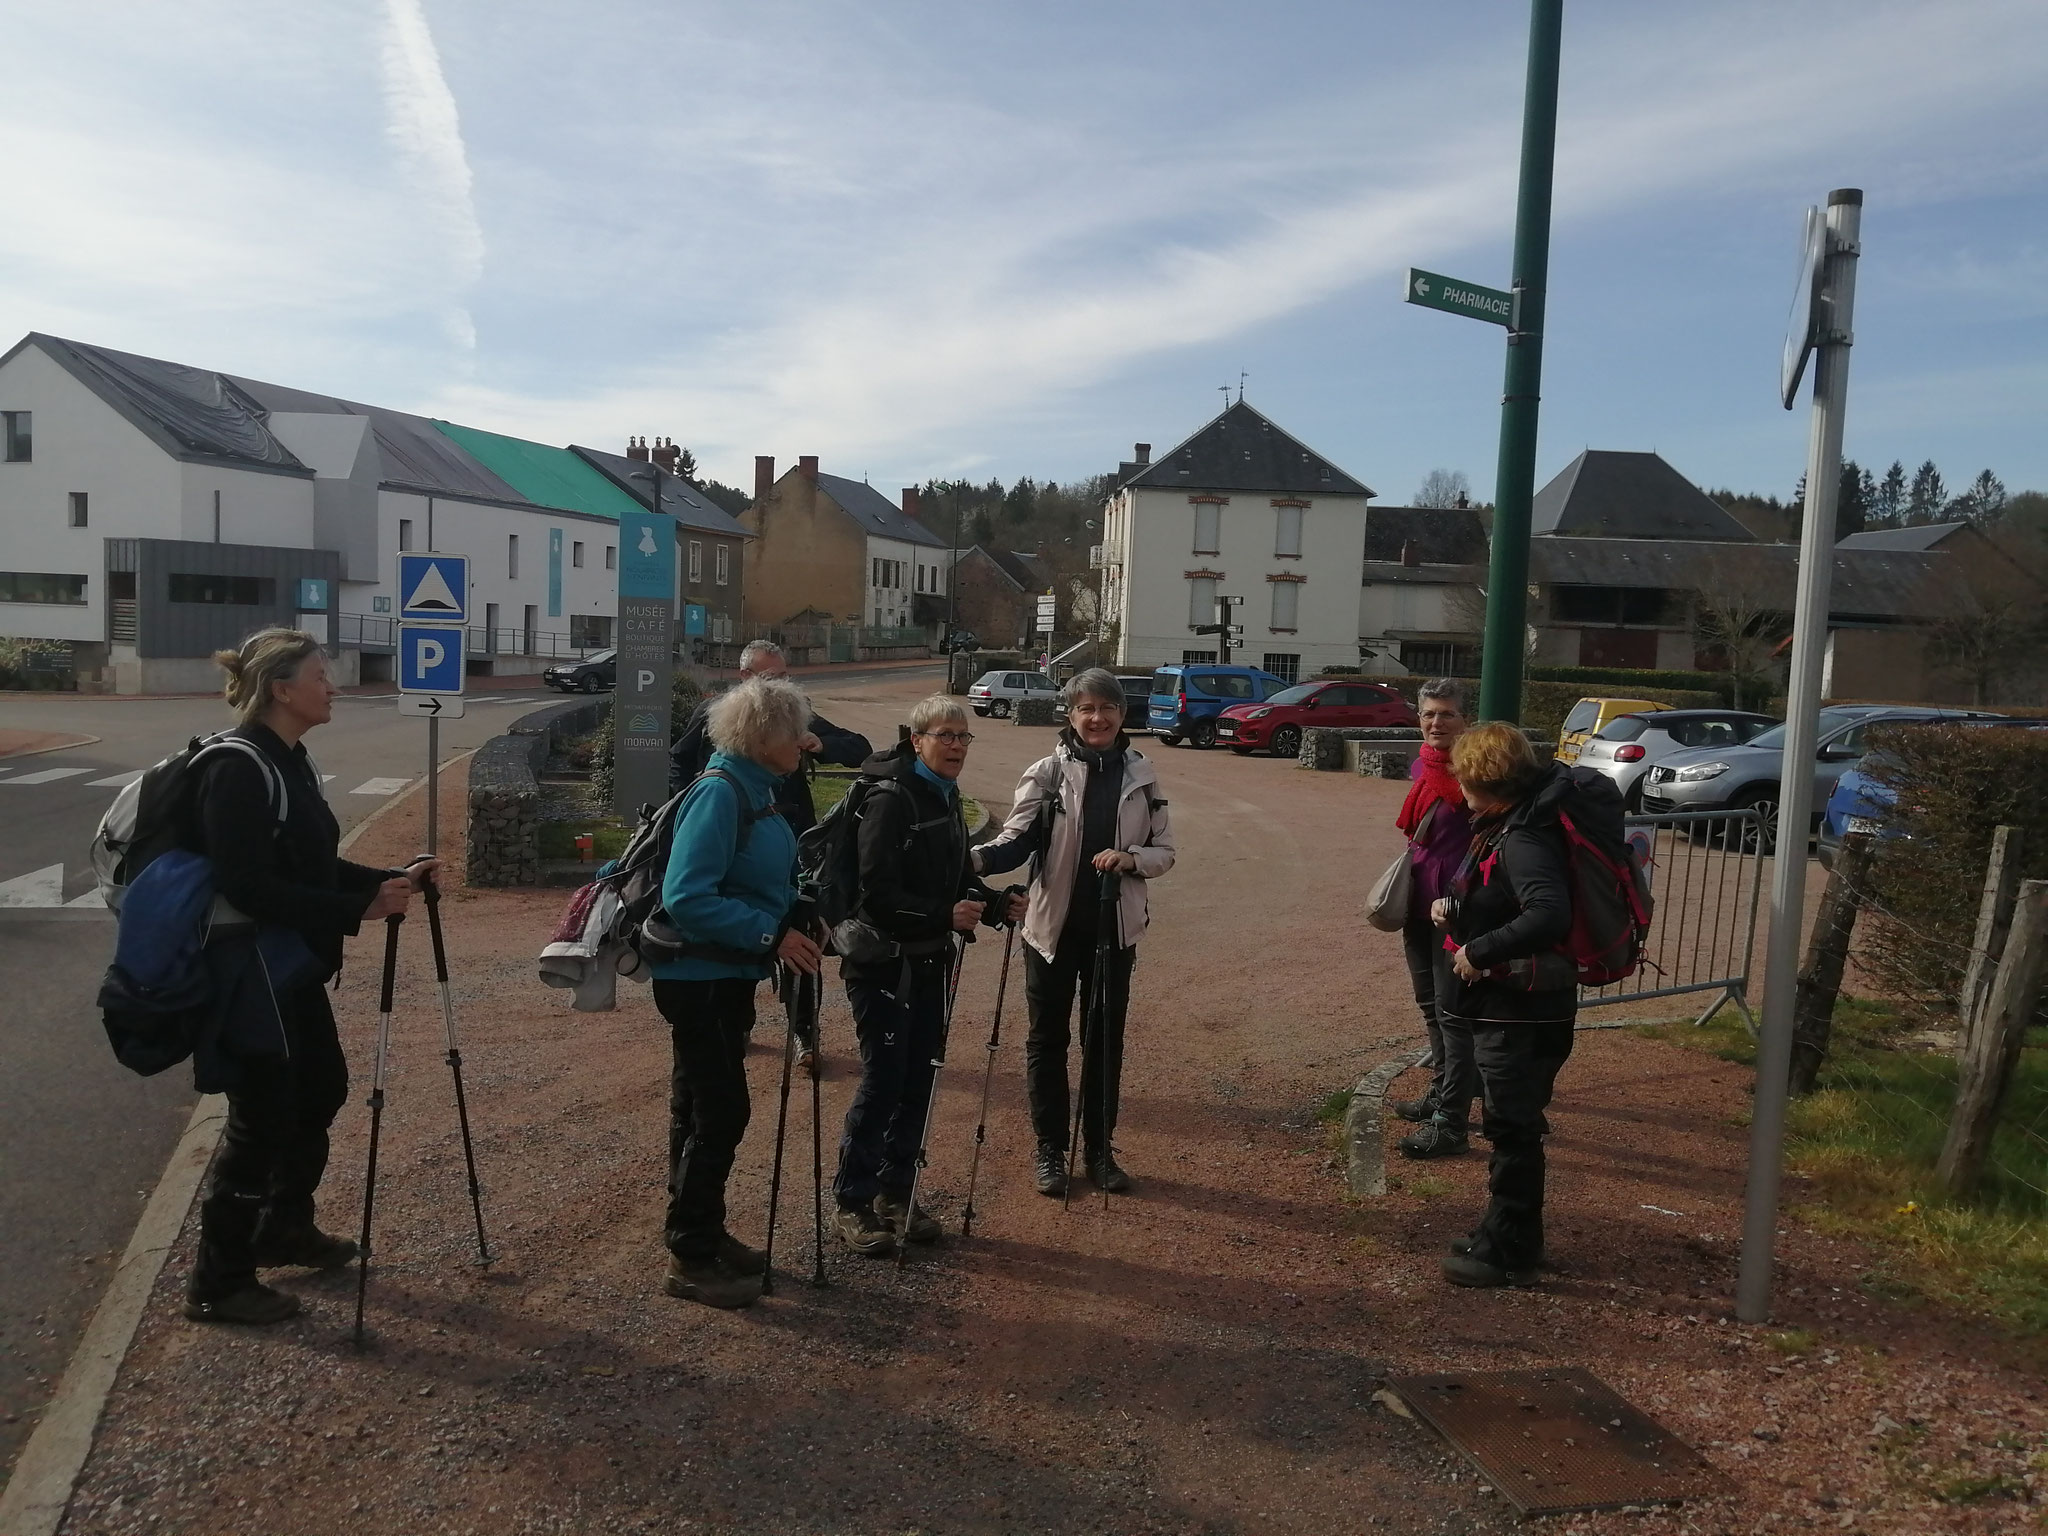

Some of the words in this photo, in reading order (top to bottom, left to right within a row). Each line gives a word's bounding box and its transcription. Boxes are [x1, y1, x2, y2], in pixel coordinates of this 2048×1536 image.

[1442, 286, 1511, 316] PHARMACIE
[626, 604, 666, 618] MUSÉE
[626, 619, 665, 631] CAFÉ
[625, 633, 665, 643] BOUTIQUE
[625, 644, 665, 653] CHAMBRES
[416, 638, 445, 679] P
[637, 669, 655, 692] P
[623, 737, 664, 748] MORVAN
